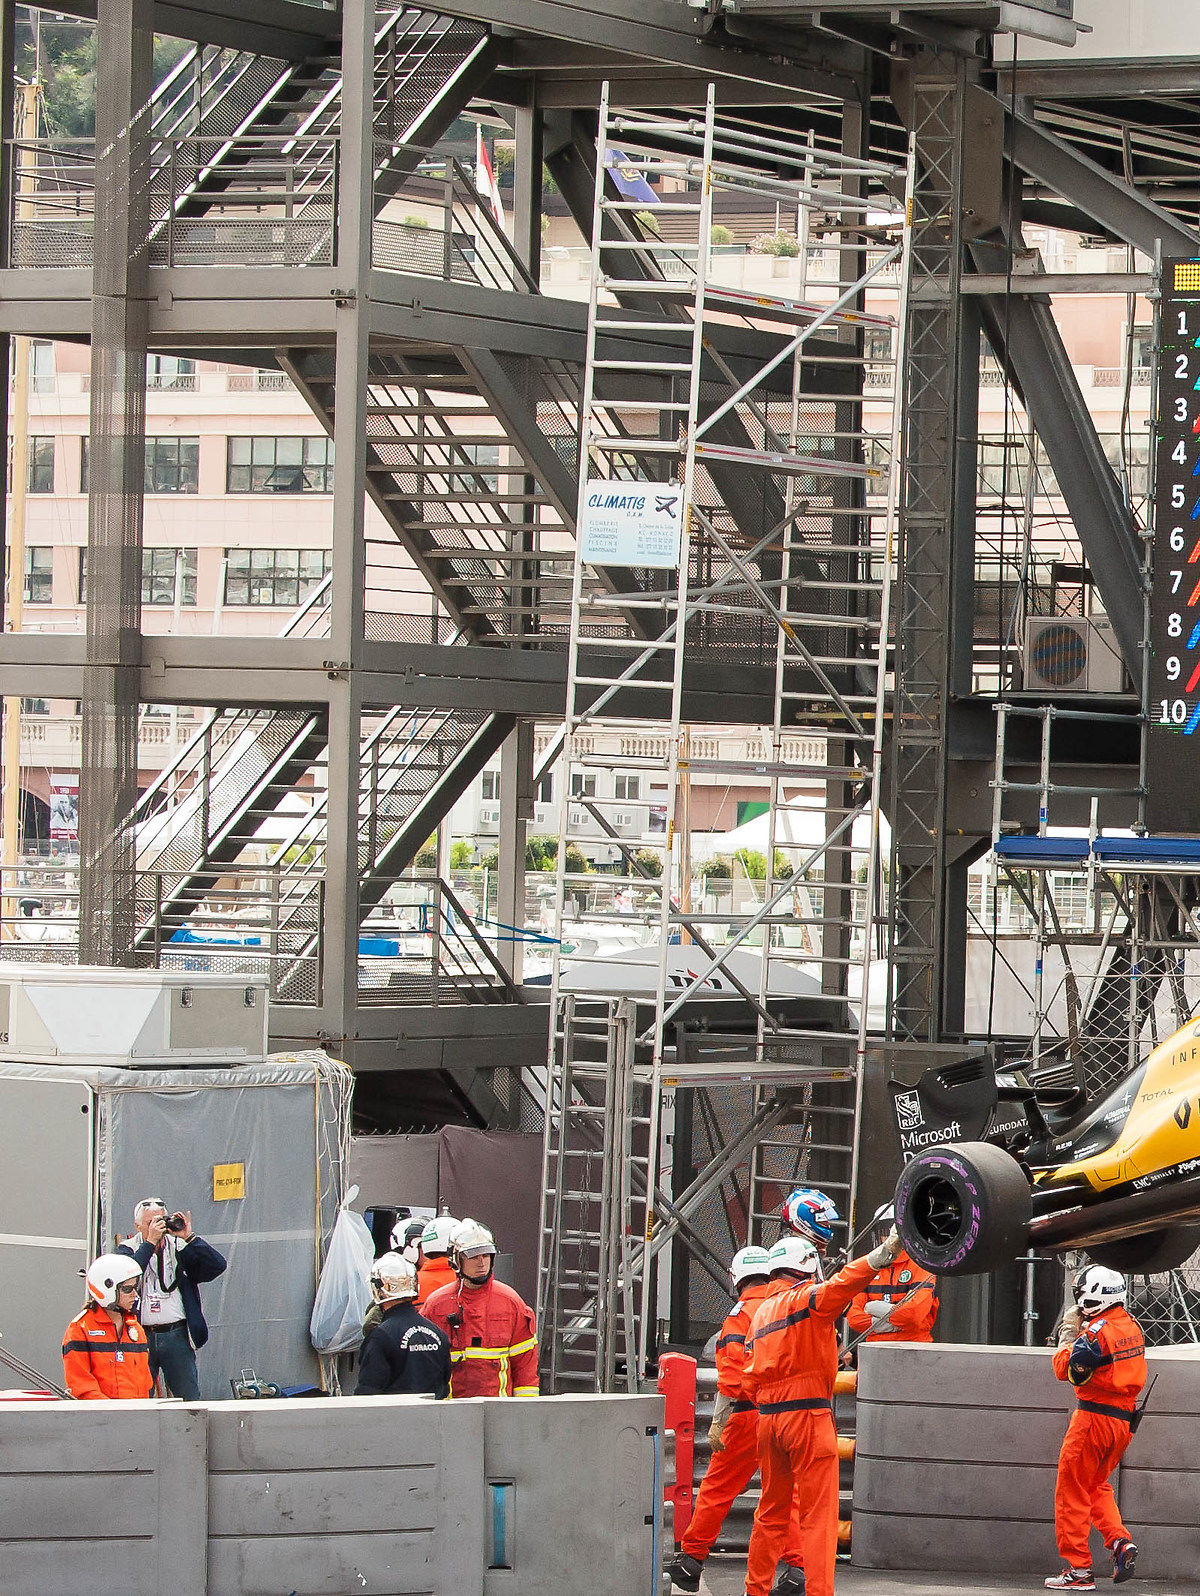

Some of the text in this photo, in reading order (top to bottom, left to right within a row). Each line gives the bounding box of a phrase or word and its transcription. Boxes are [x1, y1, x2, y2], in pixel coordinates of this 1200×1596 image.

[1177, 311, 1189, 335] 1
[1174, 353, 1189, 379] 2
[1173, 397, 1188, 422] 3
[1171, 440, 1187, 465] 4
[588, 494, 646, 510] CLIMATIS
[1170, 484, 1185, 508] 5
[1169, 526, 1185, 552] 6
[1169, 570, 1183, 594] 7
[1167, 612, 1183, 637] 8
[1165, 656, 1181, 680] 9
[1159, 699, 1187, 724] 10
[1141, 1089, 1174, 1103] TOTAL
[902, 1116, 920, 1128] RBC
[900, 1121, 962, 1148] Microsoft
[1132, 1176, 1151, 1190] EMC
